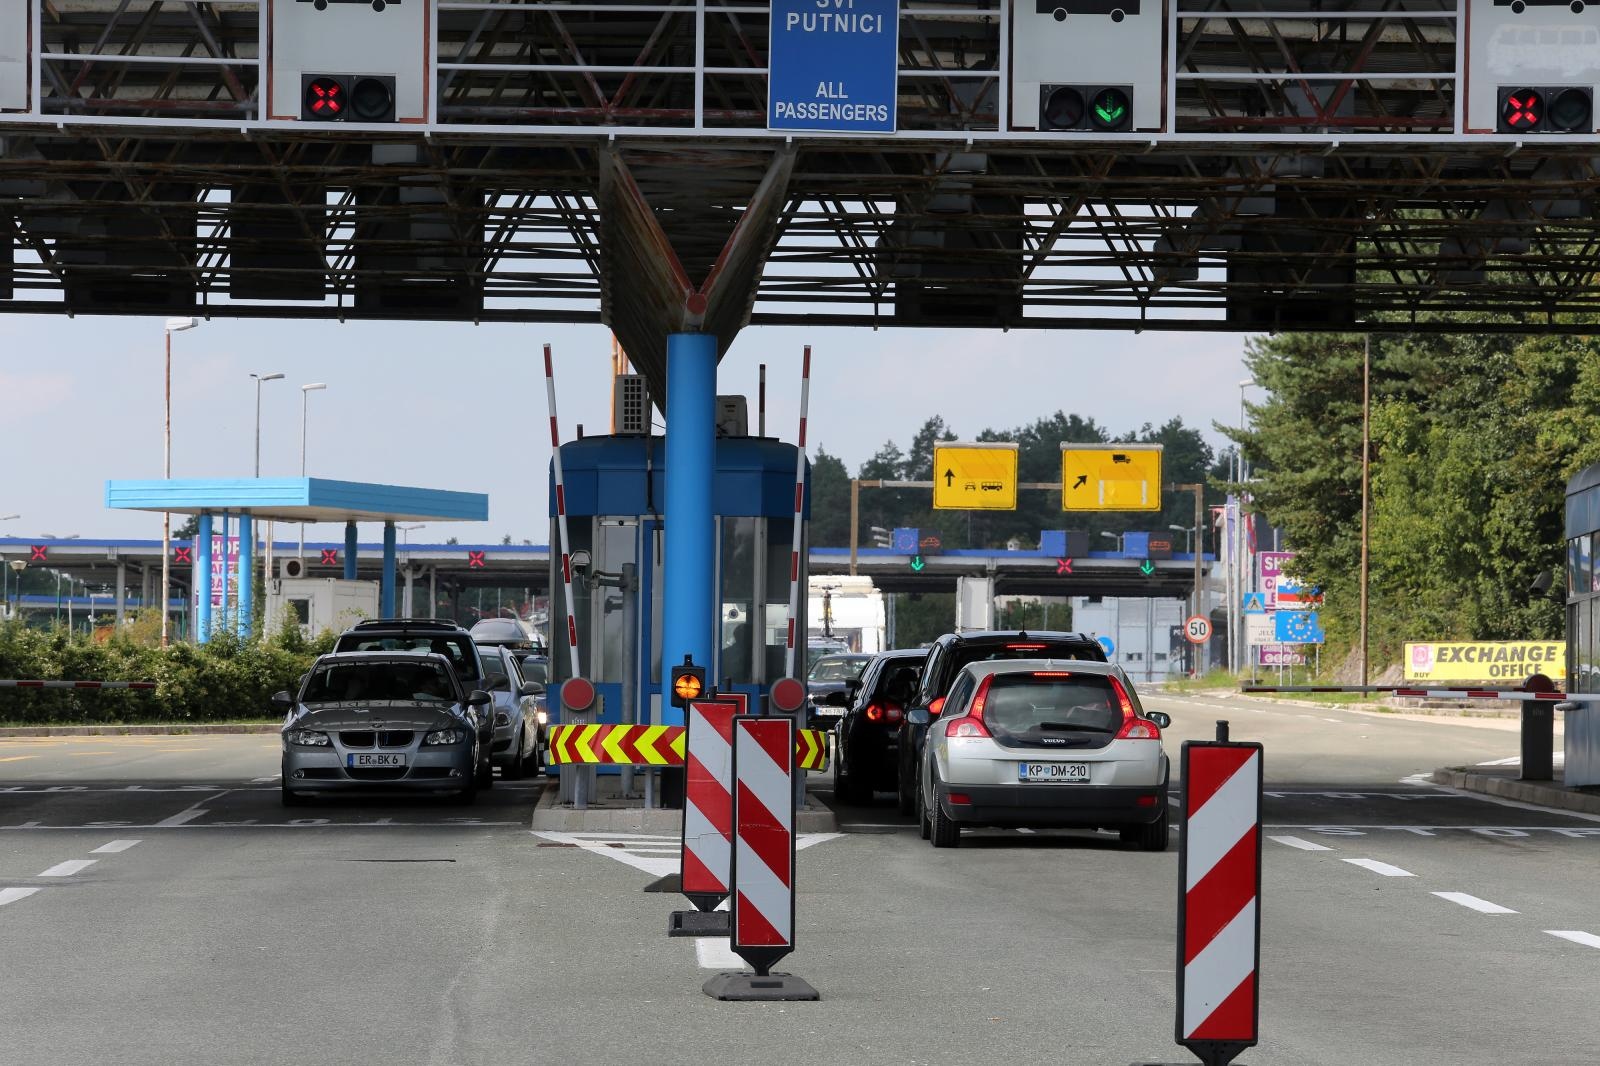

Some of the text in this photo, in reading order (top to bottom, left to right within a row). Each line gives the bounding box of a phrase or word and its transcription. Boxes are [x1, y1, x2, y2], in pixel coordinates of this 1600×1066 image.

[786, 12, 882, 33] PUTNICI
[815, 81, 849, 99] ALL
[775, 101, 888, 122] PASSENGERS
[1190, 622, 1206, 636] 50
[1435, 645, 1558, 664] EXCHANGE
[1488, 663, 1542, 678] OFFICE
[359, 755, 398, 764] ER BK 6
[1029, 765, 1086, 777] KP DM-210
